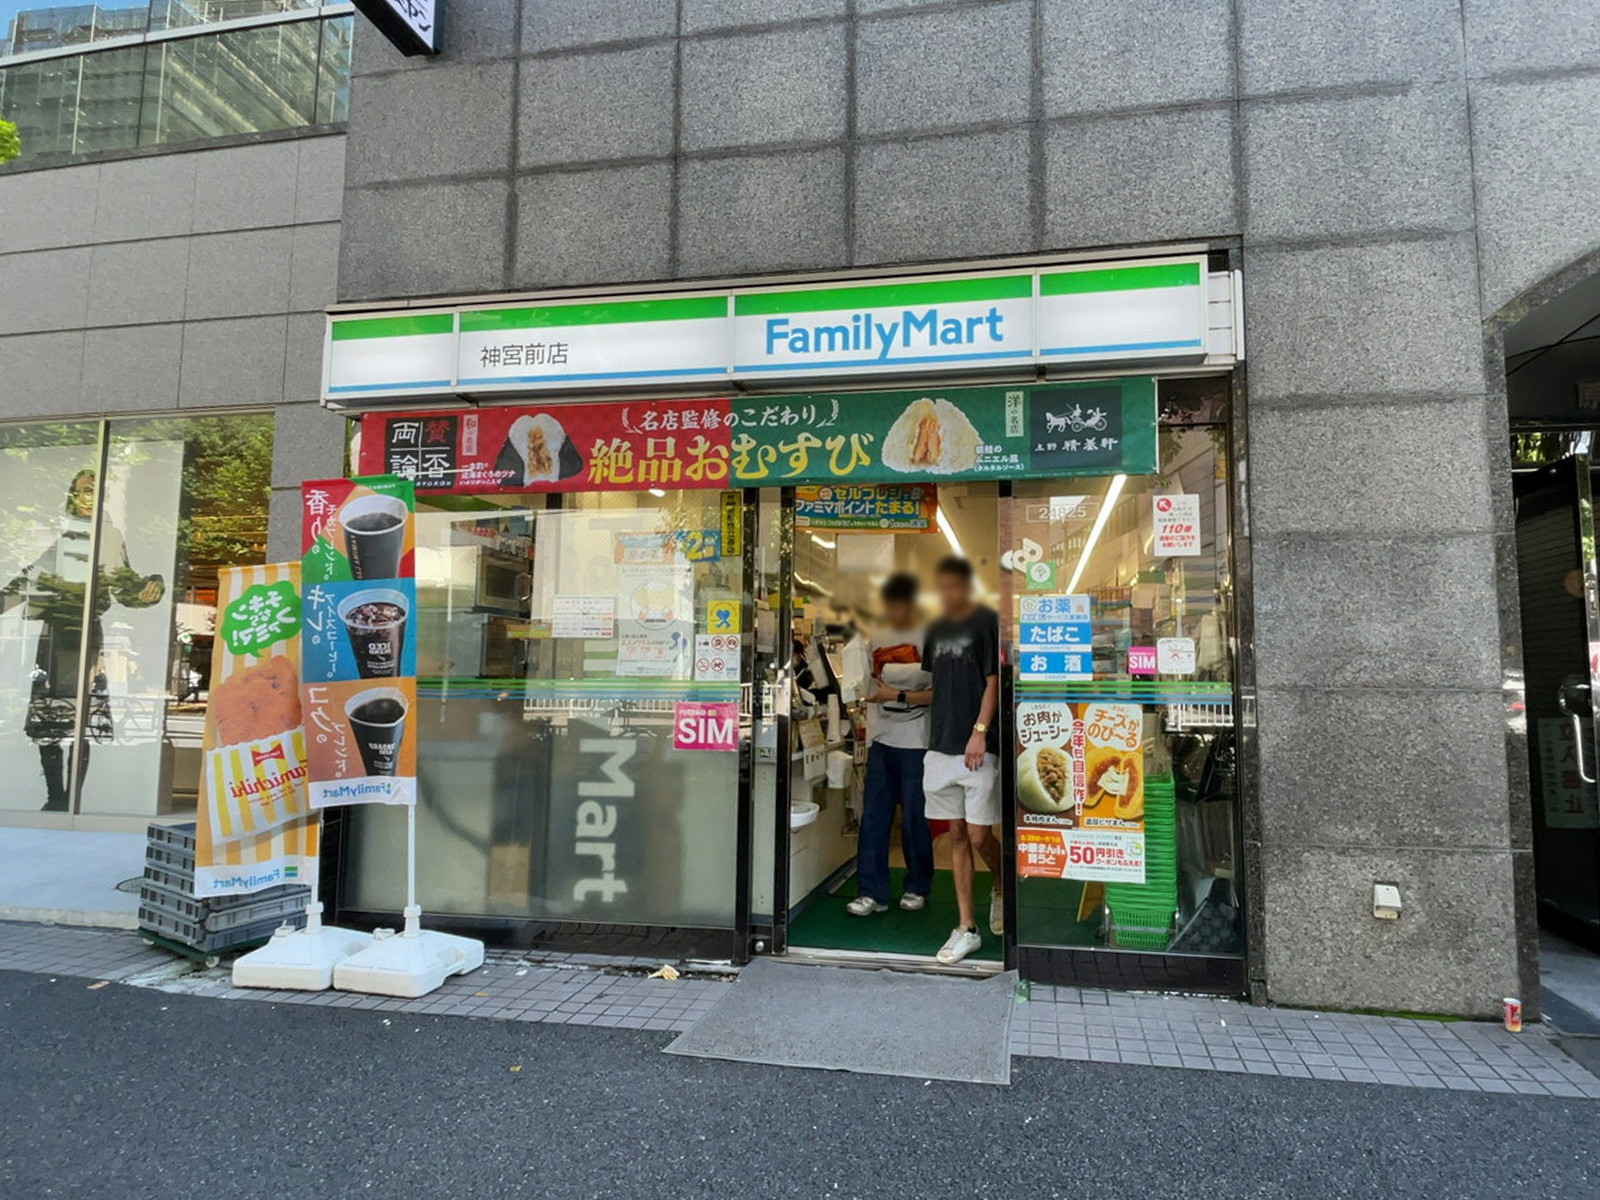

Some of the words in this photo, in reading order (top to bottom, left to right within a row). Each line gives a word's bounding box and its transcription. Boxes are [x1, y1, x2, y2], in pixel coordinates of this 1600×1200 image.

[765, 307, 1003, 361] FamilyMart
[480, 342, 569, 368] 神宮前店
[640, 404, 816, 430] 名店監修のこだわり
[587, 432, 874, 485] 絶品おむすび
[1038, 598, 1071, 614] お薬
[1030, 625, 1080, 643] たばこ
[1030, 654, 1082, 672] お酒
[1129, 656, 1156, 669] SIM
[1023, 711, 1063, 726] お肉が
[1094, 708, 1140, 732] チーズが
[678, 717, 734, 745] SIM
[1020, 724, 1069, 744] ジューシー
[573, 738, 638, 903] Mart
